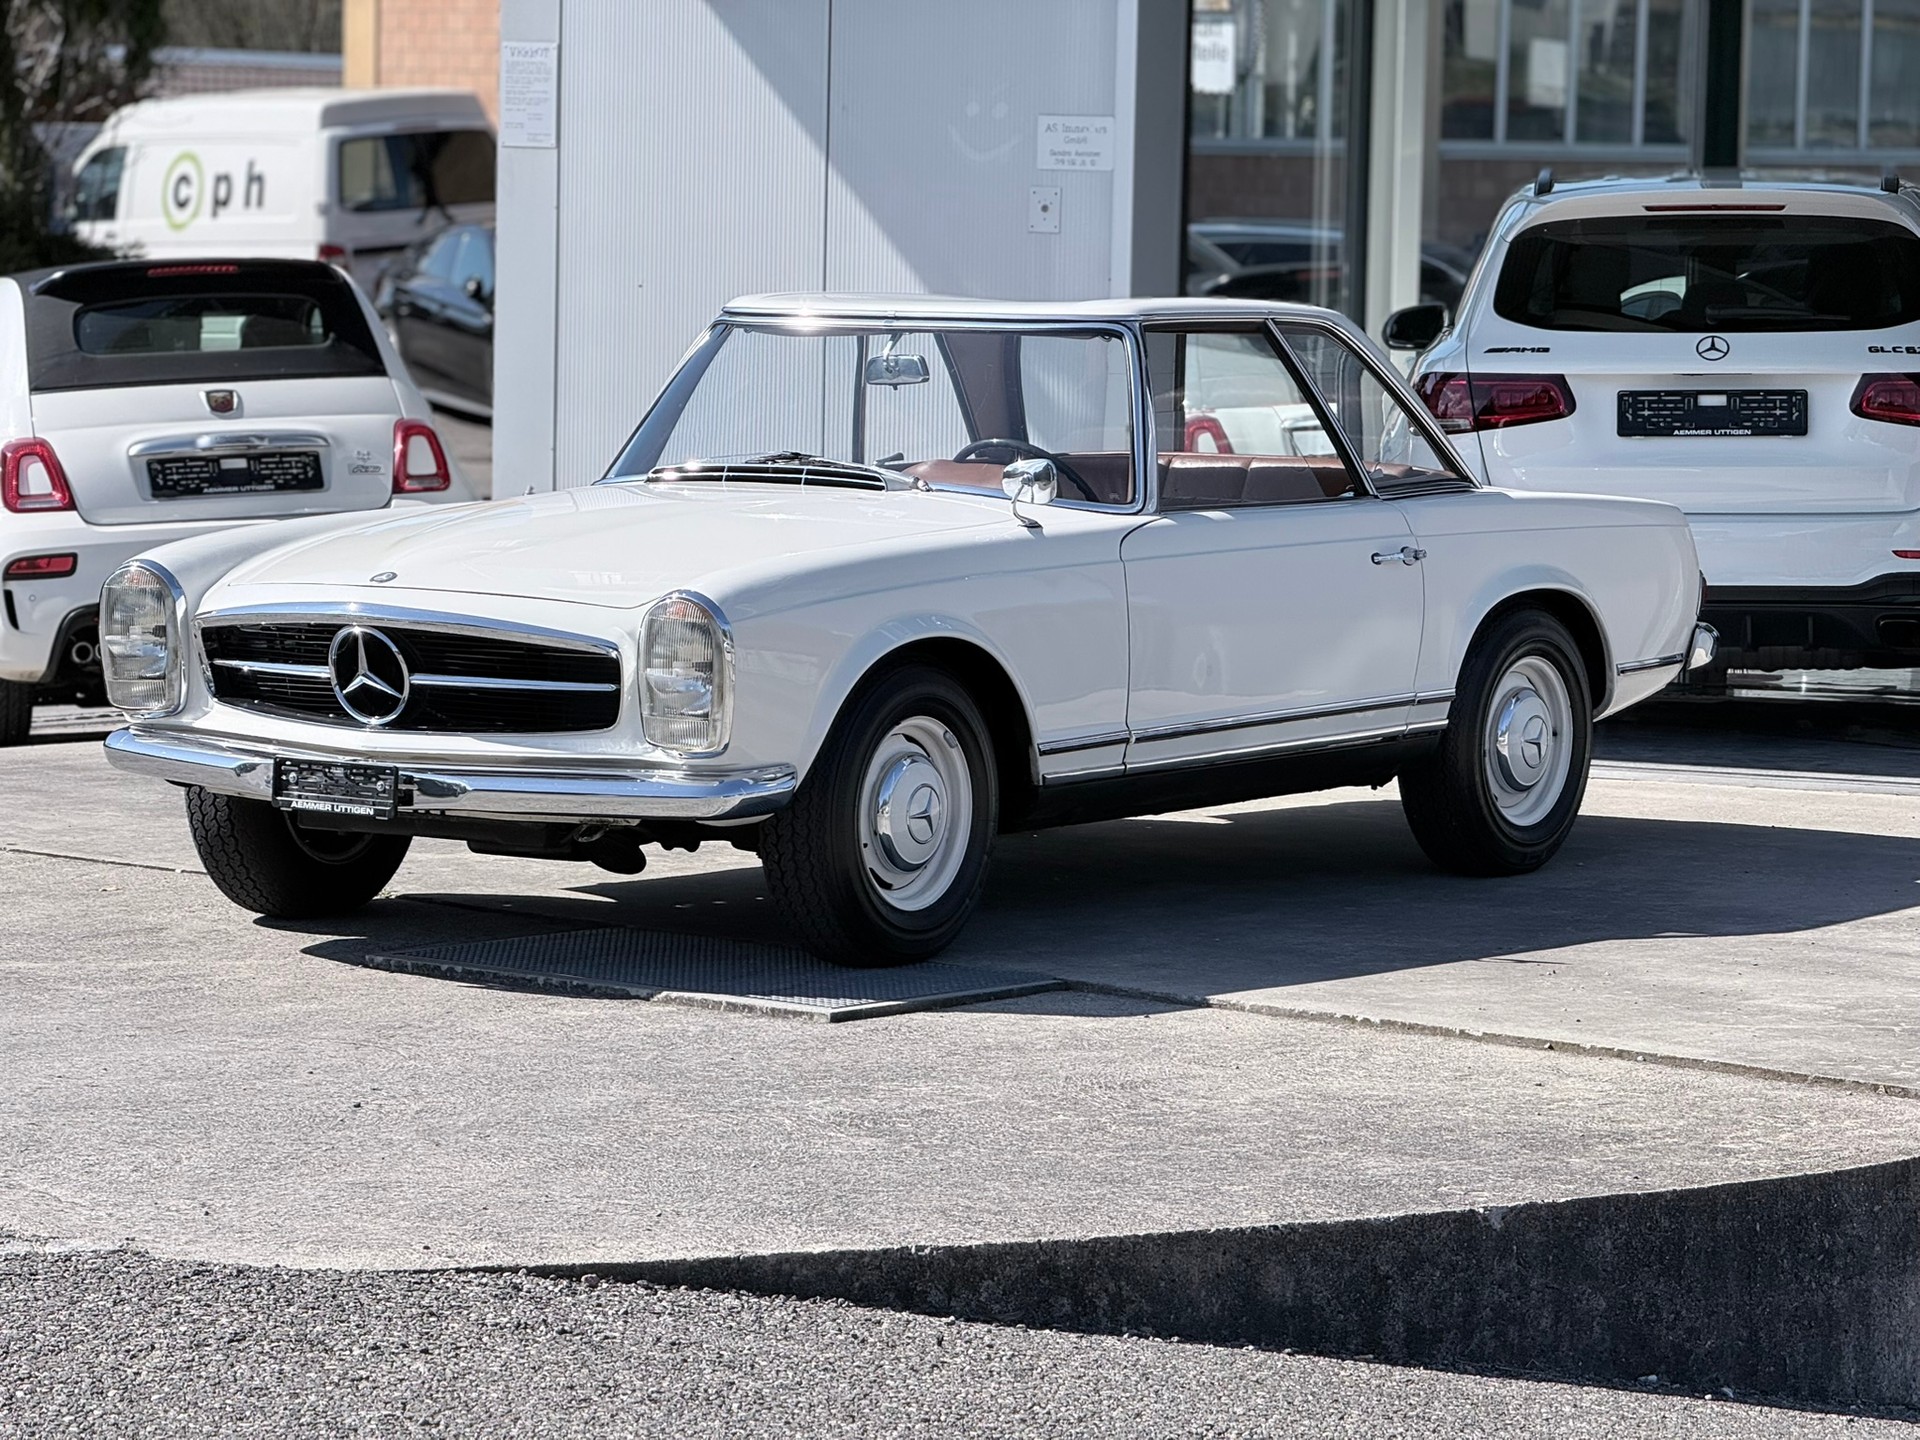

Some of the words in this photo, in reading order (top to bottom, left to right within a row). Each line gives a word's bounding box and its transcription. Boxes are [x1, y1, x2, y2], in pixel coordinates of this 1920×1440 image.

[173, 158, 264, 218] cph
[240, 484, 275, 492] UTTIGEN
[290, 801, 332, 812] AEMMER
[333, 804, 374, 816] UTTIGEN
